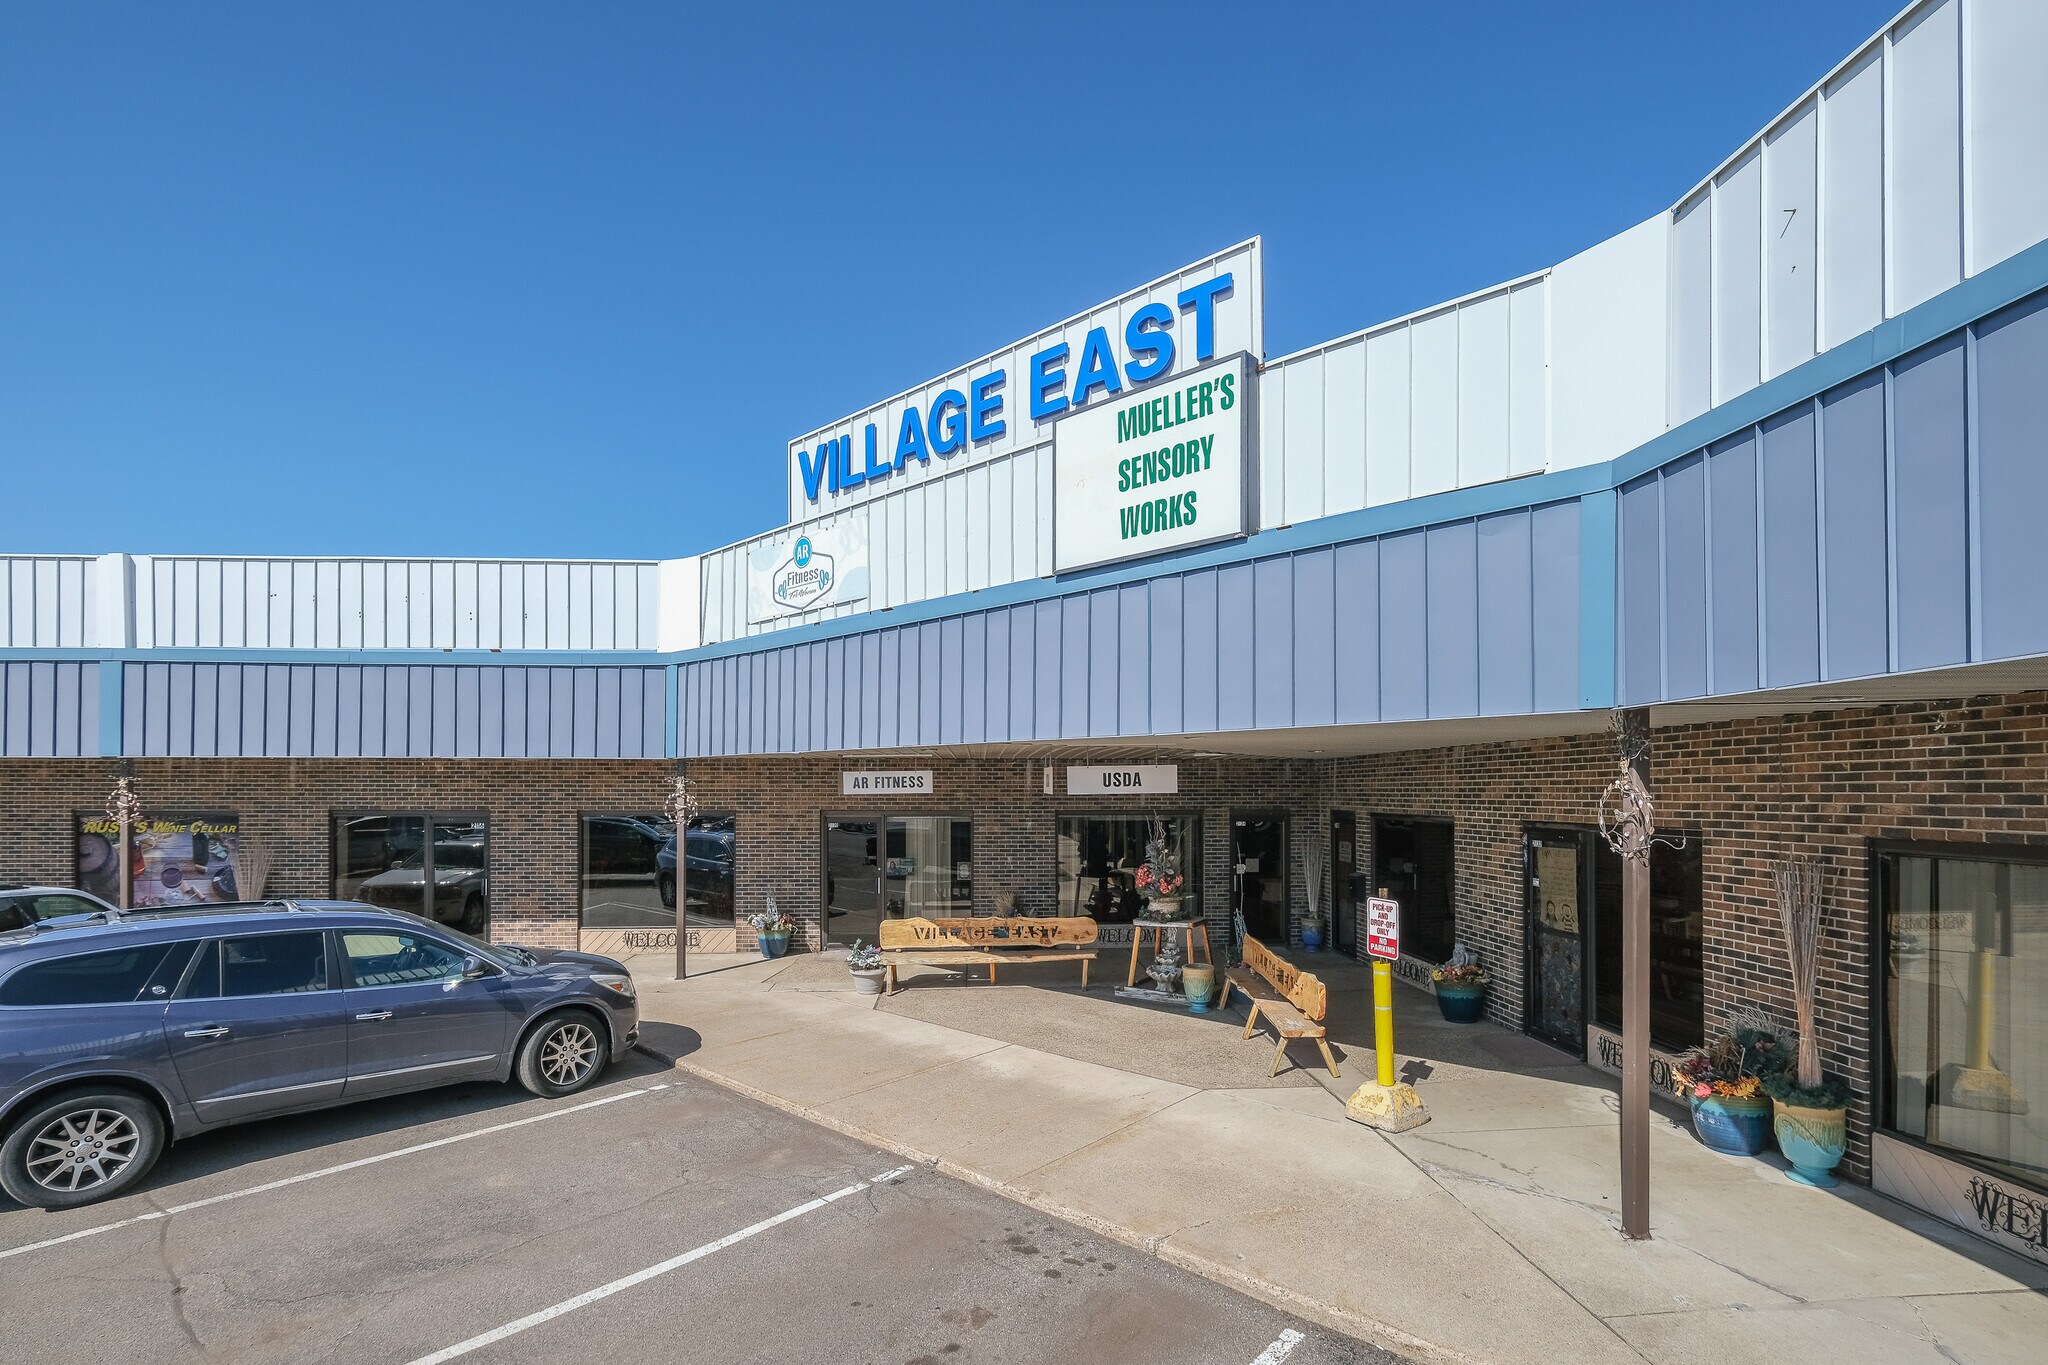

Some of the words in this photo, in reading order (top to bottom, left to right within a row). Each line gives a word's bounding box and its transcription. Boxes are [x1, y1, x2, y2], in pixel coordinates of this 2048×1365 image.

[797, 368, 1006, 500] VILLAGE
[1029, 272, 1234, 420] EAST
[1117, 373, 1235, 444] MUELLER'S
[1118, 433, 1215, 493] SENSORY
[1120, 490, 1197, 540] WORKS
[796, 544, 809, 561] AR
[787, 568, 819, 587] Fitness
[852, 775, 869, 790] AR
[874, 775, 925, 790] FITNESS
[1102, 771, 1143, 788] USDA
[1373, 903, 1393, 912] PICK-UP
[1378, 912, 1388, 920] AND
[1371, 919, 1395, 929] DROP-OFF
[1377, 928, 1389, 936] ONLY
[623, 930, 701, 949] WELCOE
[913, 926, 995, 941] VILLAGE
[1009, 925, 1060, 940] EAST
[1371, 943, 1395, 954] PARKING
